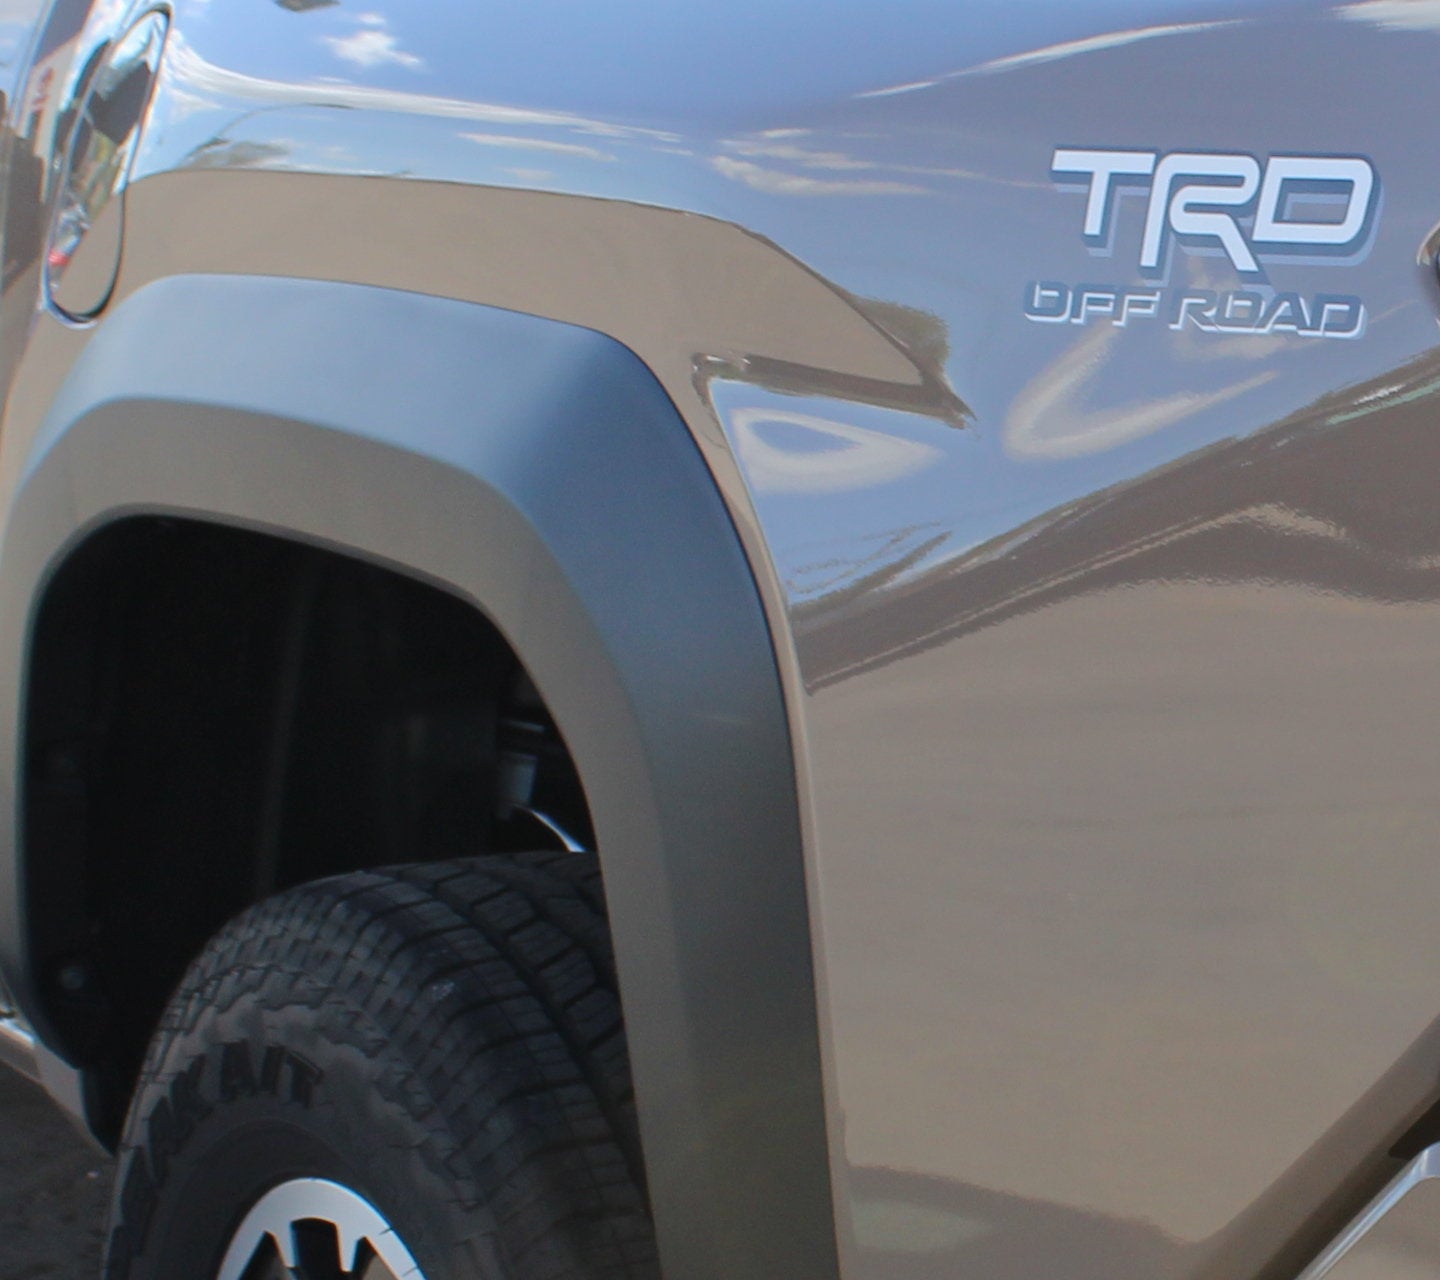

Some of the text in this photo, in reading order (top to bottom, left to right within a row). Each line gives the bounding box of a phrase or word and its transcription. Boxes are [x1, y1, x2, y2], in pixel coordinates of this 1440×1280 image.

[1051, 150, 1373, 272] TRD
[1024, 281, 1368, 340] OFF ROAD
